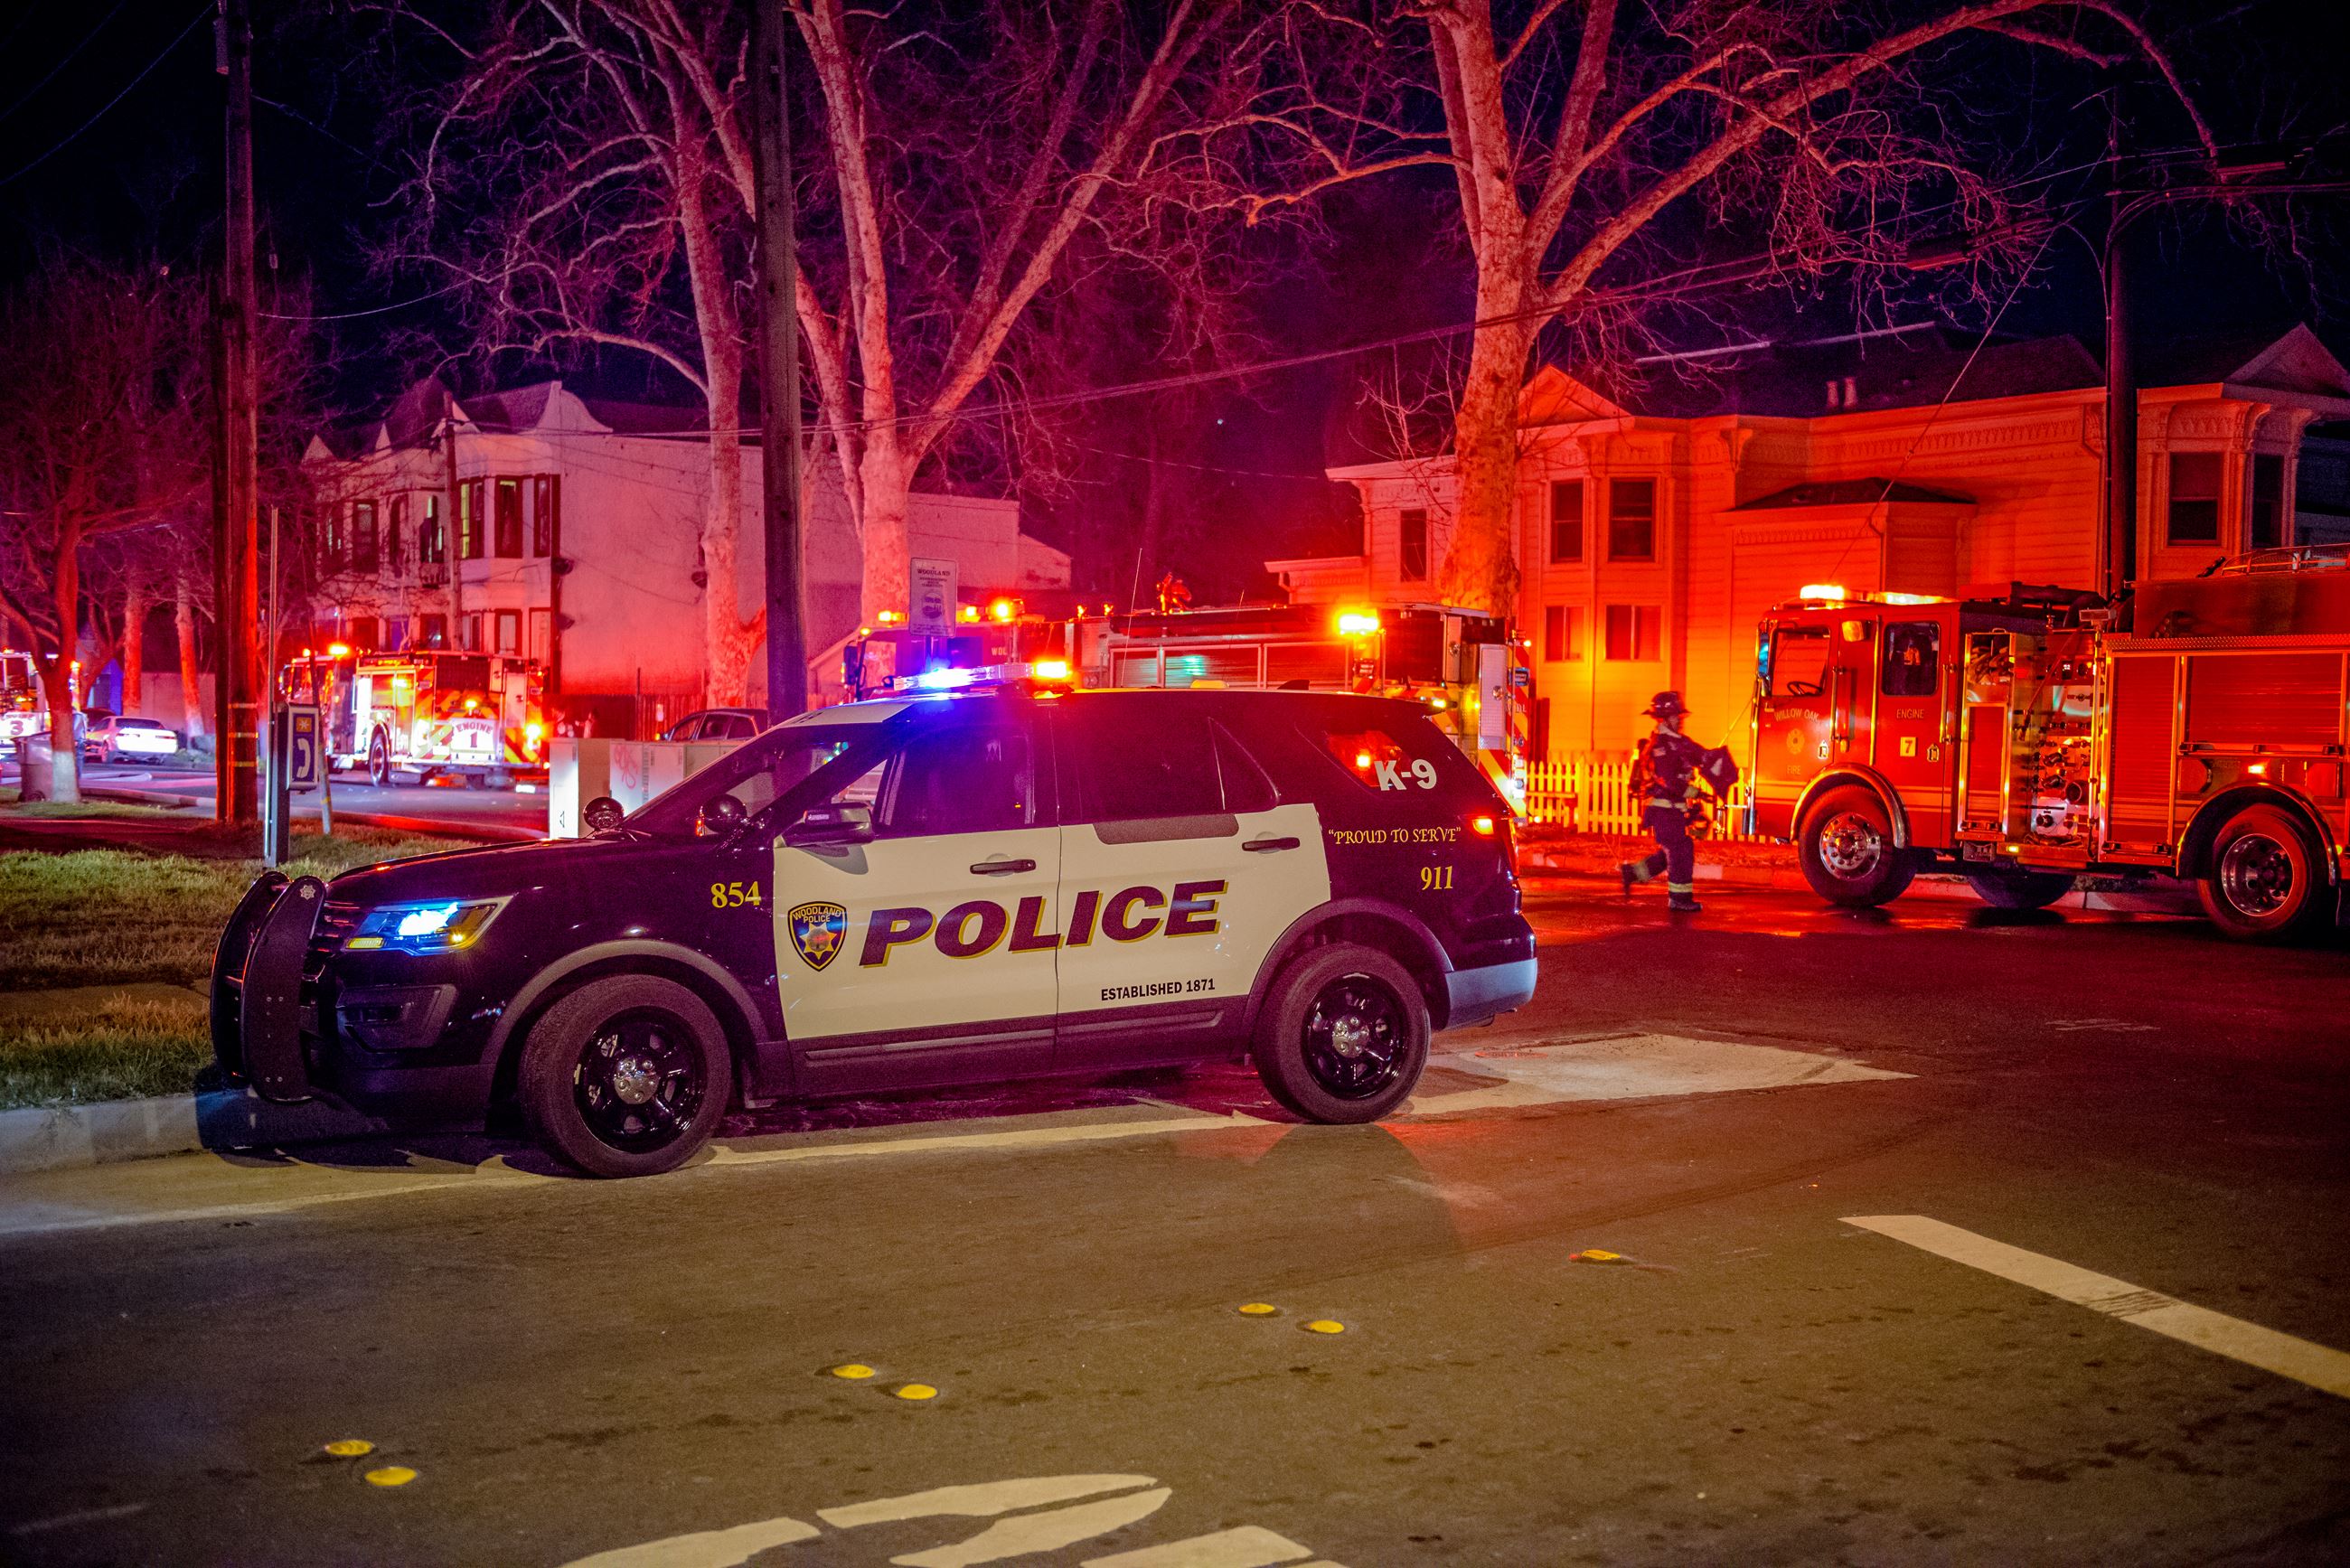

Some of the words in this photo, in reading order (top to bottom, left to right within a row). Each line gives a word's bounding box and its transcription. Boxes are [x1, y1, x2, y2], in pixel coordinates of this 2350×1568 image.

[916, 568, 951, 577] WOODLAND
[991, 646, 1008, 656] WDL
[1773, 708, 1802, 722] WILLOW
[1803, 709, 1819, 722] OAK
[1895, 709, 1925, 720] ENGINE
[10, 719, 24, 736] 3
[455, 721, 494, 735] ENGINE
[470, 730, 478, 748] 1
[1904, 739, 1913, 754] 7
[1373, 758, 1437, 792] K-9
[1787, 765, 1801, 776] FIRE
[1390, 827, 1409, 843] TO
[1420, 865, 1453, 891] 911
[710, 880, 762, 908] 854
[792, 906, 842, 921] WOODLAND
[803, 914, 831, 924] POLICE
[858, 878, 1229, 969] POLICE
[1101, 981, 1183, 1001] ESTABLISHED
[1186, 978, 1216, 993] 1871
